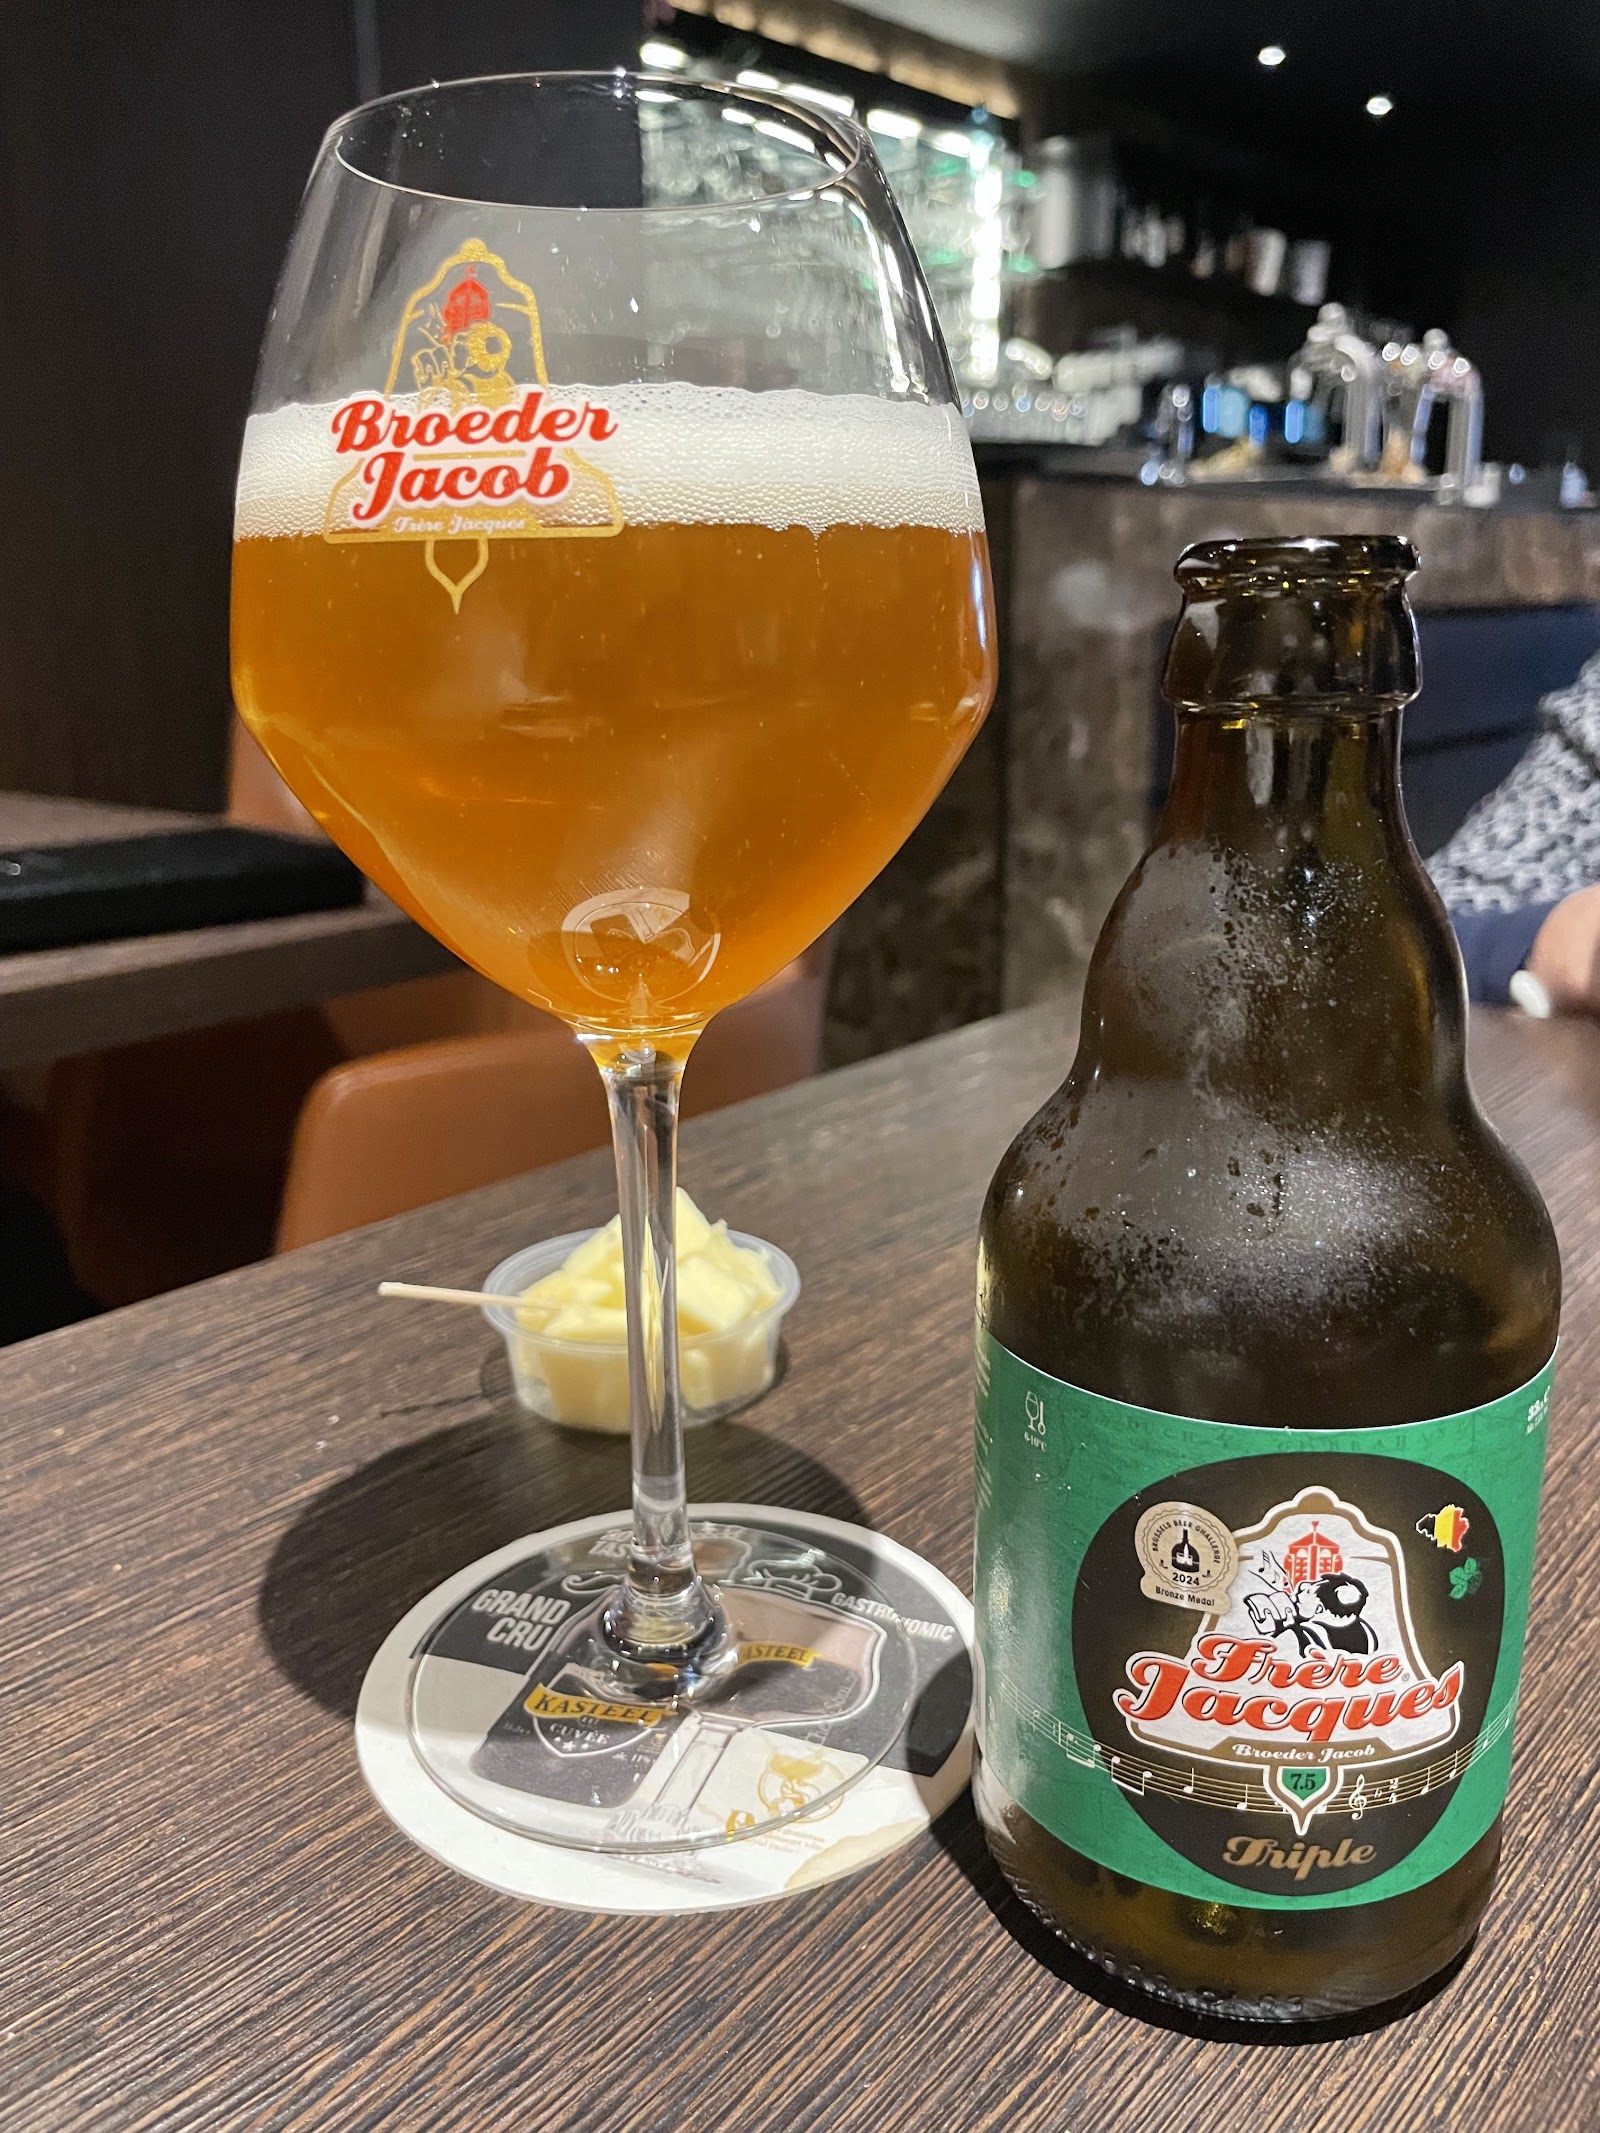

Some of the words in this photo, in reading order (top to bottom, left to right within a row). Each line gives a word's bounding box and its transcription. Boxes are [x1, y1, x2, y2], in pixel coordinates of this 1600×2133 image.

[331, 392, 619, 455] Broeder
[352, 447, 570, 521] Jacob
[447, 514, 526, 535] Jacques
[1152, 1521, 1172, 1552] BRUSSELS
[1173, 1519, 1193, 1528] BEER
[1194, 1525, 1221, 1564] CHALLENGE
[1155, 1585, 1185, 1601] Bronze
[1187, 1594, 1215, 1607] Medal
[1172, 1572, 1200, 1586] 2024
[471, 1588, 572, 1625] GRAND
[486, 1617, 553, 1651] CRU
[1190, 1632, 1404, 1690] Frère
[534, 1694, 652, 1722] KASTEEL
[1116, 1656, 1462, 1743] Jacques
[549, 1723, 610, 1745] CUVÉE
[1232, 1743, 1316, 1760] Broeder
[1317, 1744, 1376, 1763] Jacob
[1290, 1772, 1317, 1791] 7.5
[1222, 1835, 1378, 1881] Triple
